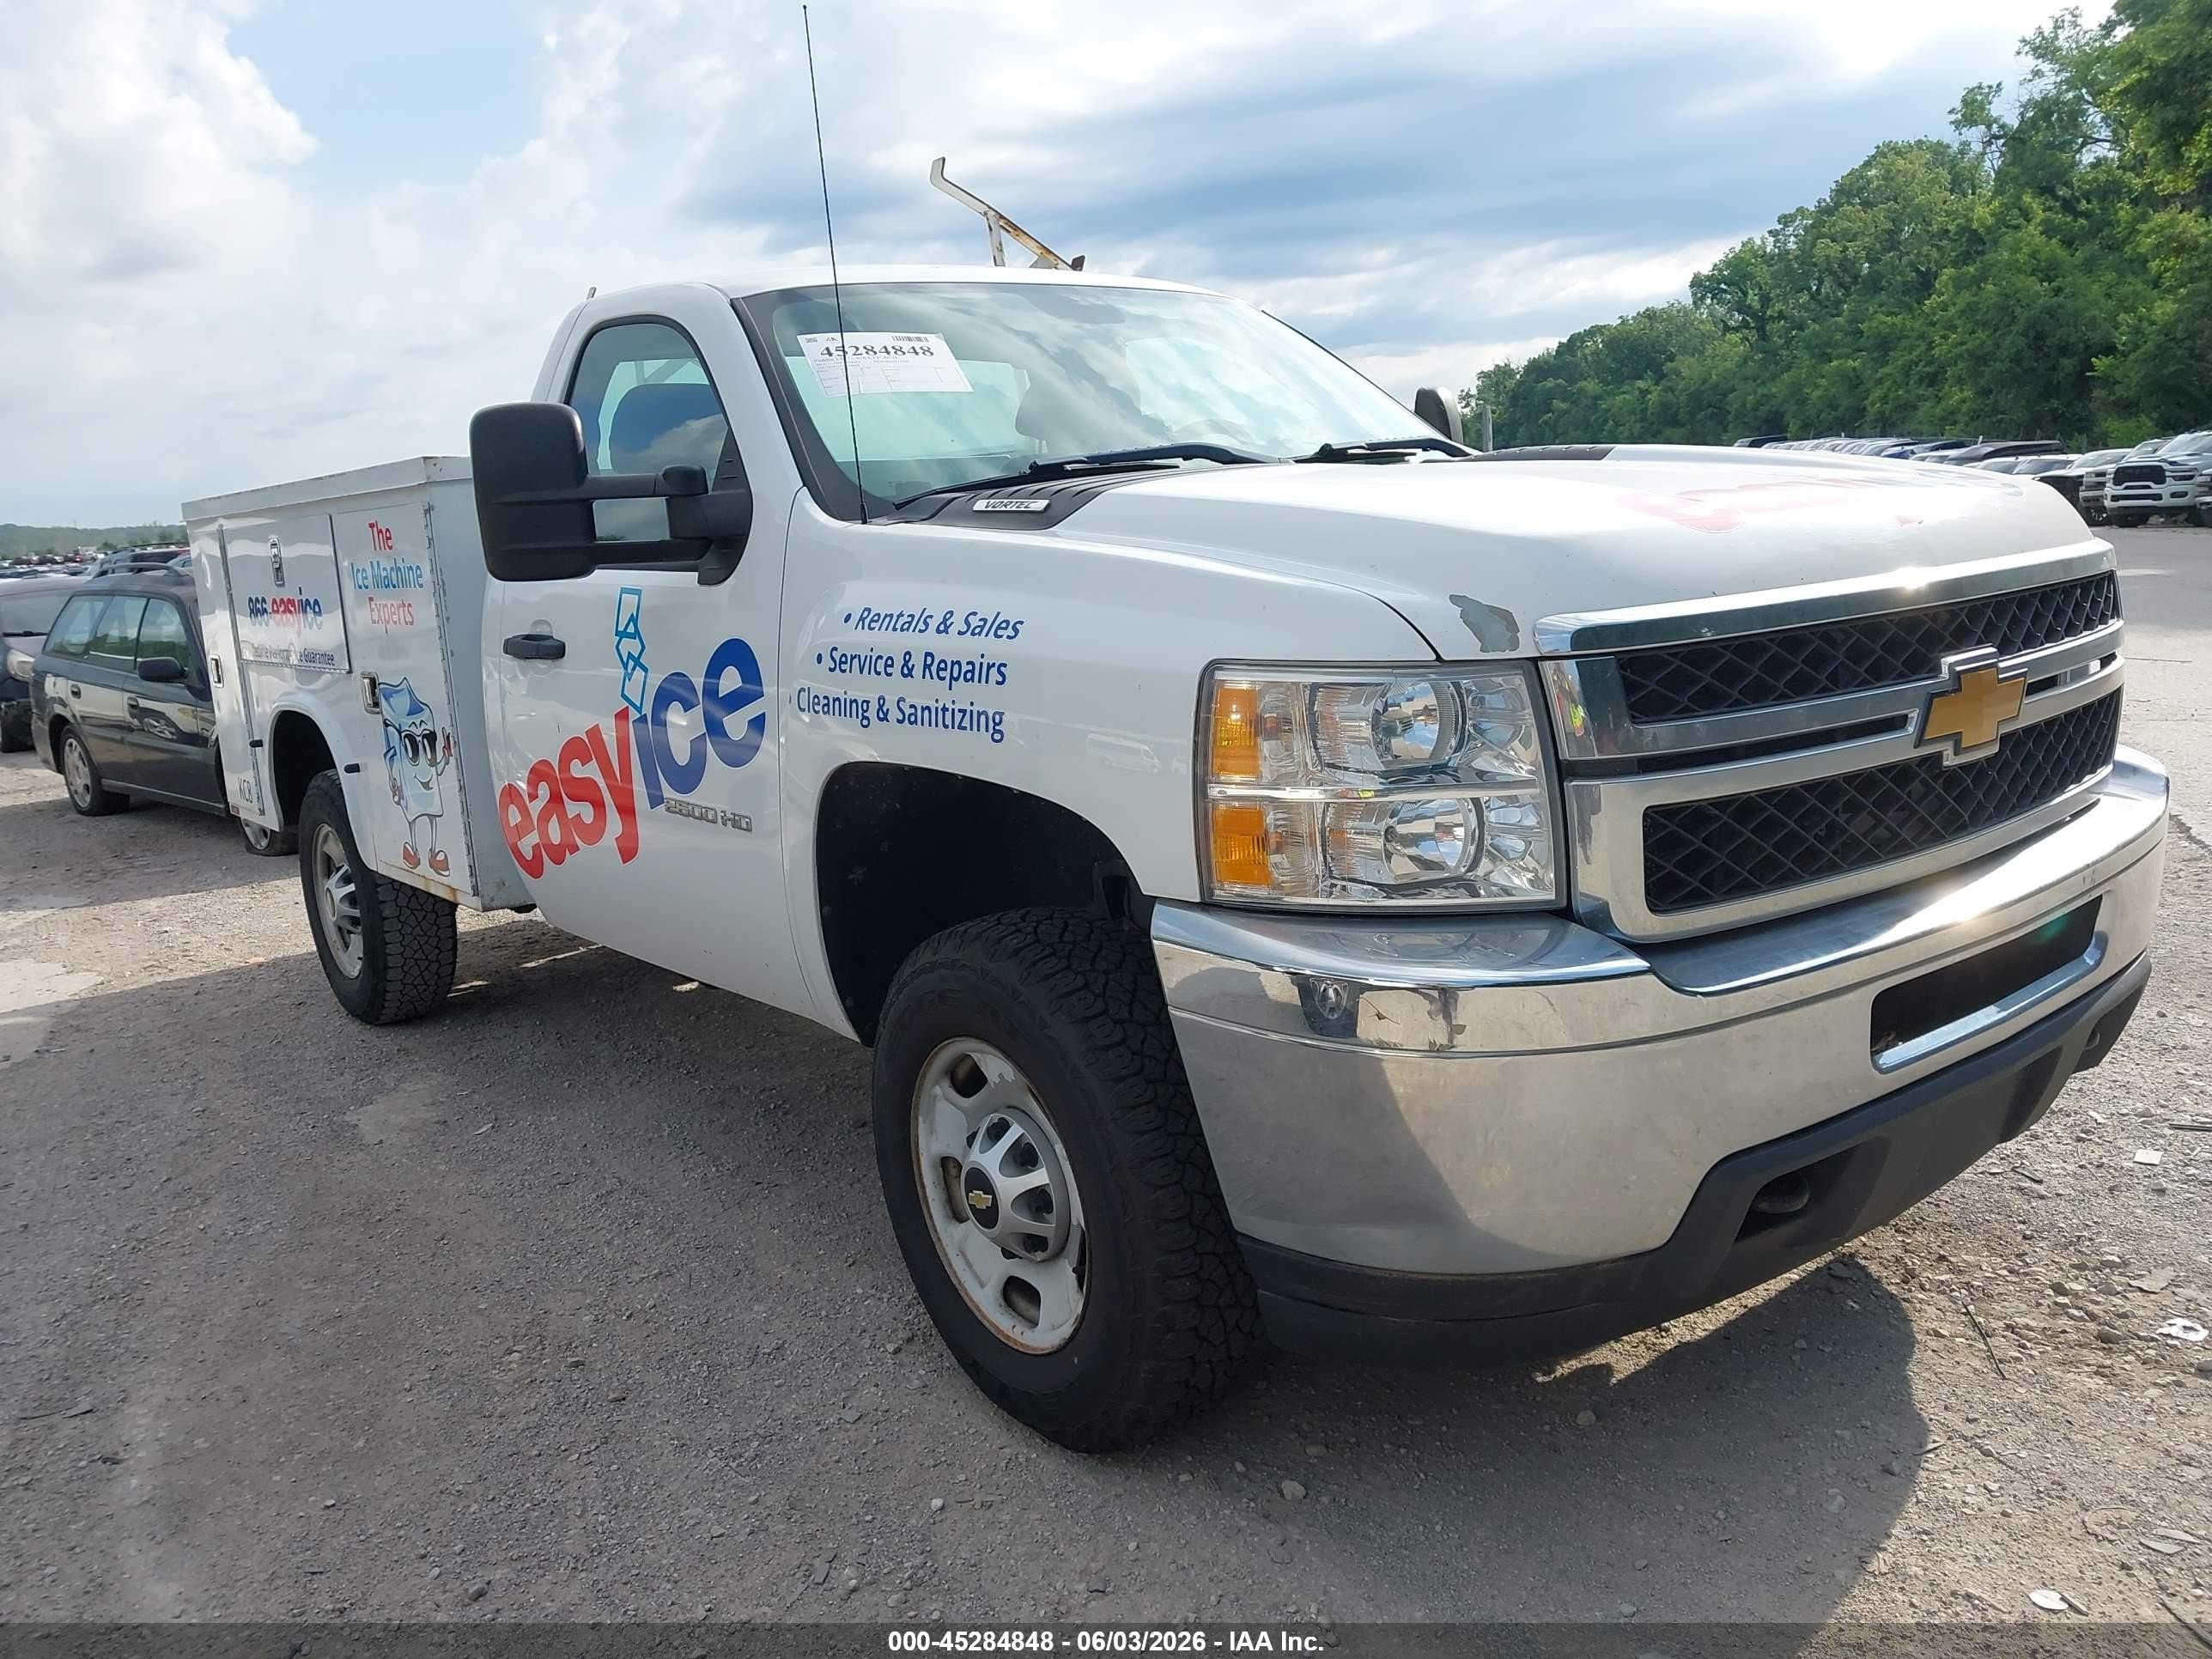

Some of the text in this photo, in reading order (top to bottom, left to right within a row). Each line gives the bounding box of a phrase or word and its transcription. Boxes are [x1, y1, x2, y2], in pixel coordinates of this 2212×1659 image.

[820, 344, 934, 357] 45284848
[984, 501, 1040, 509] VORTEC
[368, 520, 393, 550] The
[350, 557, 424, 590] Ice Machine
[368, 596, 414, 634] Experts
[854, 606, 1024, 640] Rentals & Sales
[303, 647, 335, 666] Guarantee
[829, 647, 1008, 690] Service & Repairs
[797, 687, 1005, 744] Cleaning & Sanitizing
[665, 798, 718, 823] 2500
